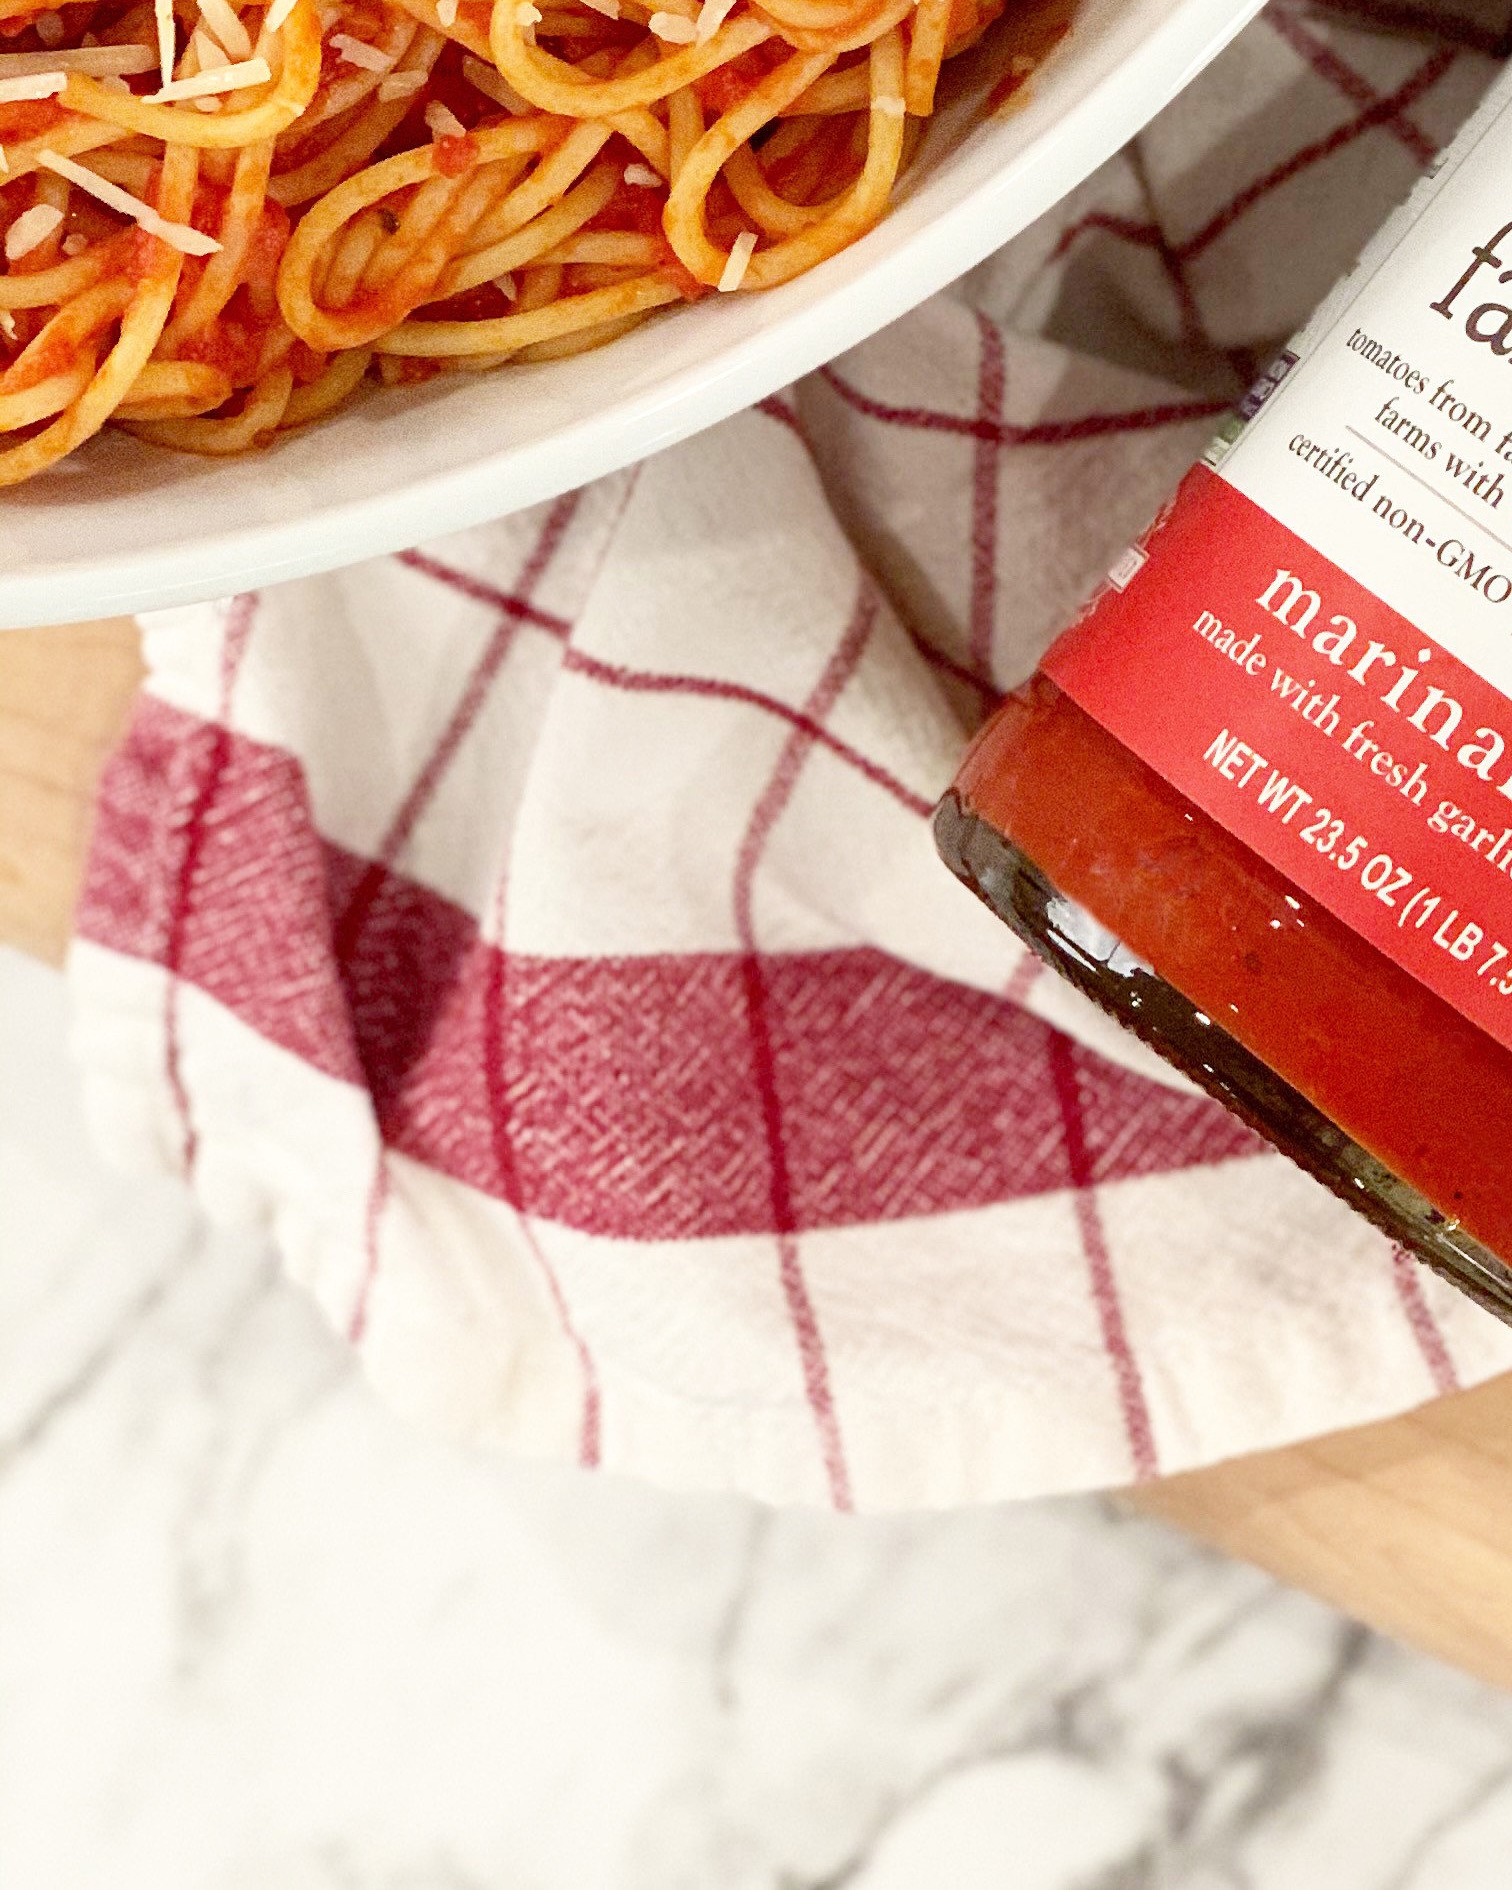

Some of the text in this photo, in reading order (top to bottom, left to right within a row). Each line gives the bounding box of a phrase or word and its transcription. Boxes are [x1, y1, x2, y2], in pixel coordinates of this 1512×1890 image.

[1346, 328, 1430, 395] tomatoes
[1429, 380, 1491, 441] from
[1375, 397, 1504, 508] farms with
[1289, 435, 1512, 603] certified non-GMO
[1193, 611, 1266, 675] made
[1271, 668, 1340, 736] with
[1342, 721, 1428, 806] fresh
[1203, 729, 1268, 788] NET
[1258, 770, 1312, 823] WT
[1300, 809, 1368, 869] 23.5
[1361, 855, 1412, 907] OZ
[1398, 888, 1441, 928] (1
[1433, 910, 1483, 960] LB
